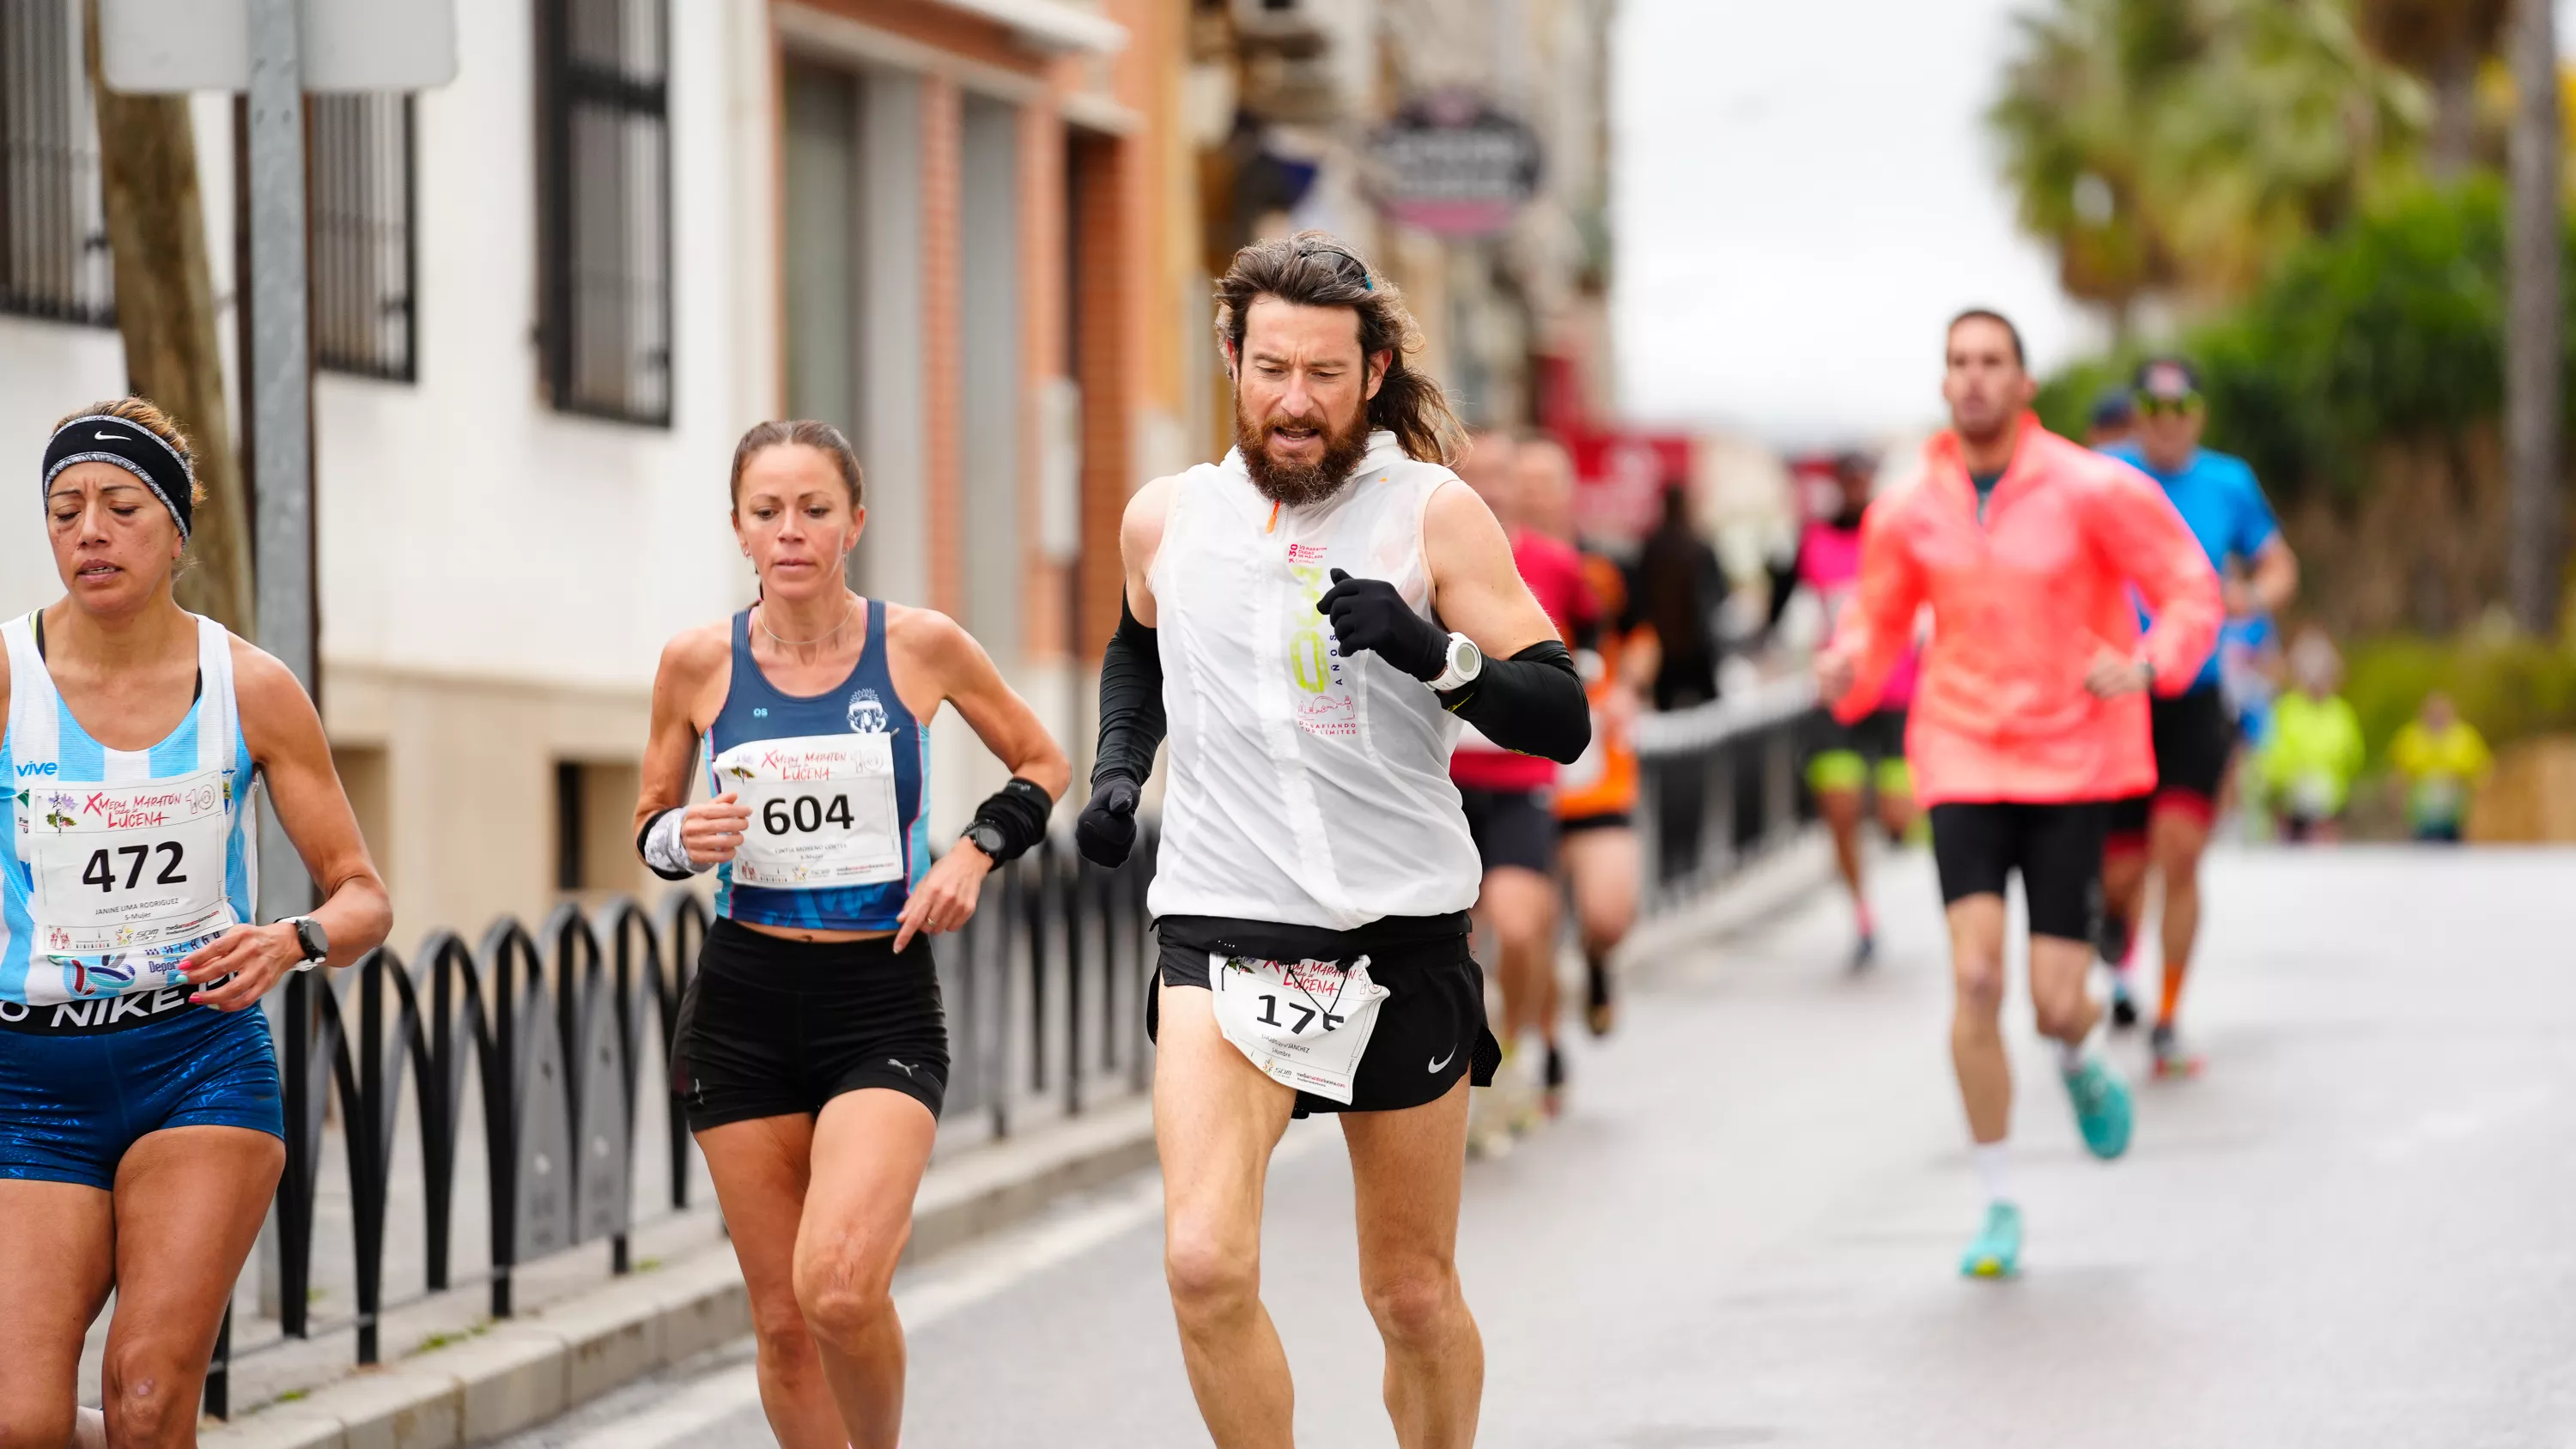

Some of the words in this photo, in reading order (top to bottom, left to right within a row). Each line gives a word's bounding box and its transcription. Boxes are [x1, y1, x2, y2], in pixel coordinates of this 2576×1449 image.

[753, 707, 769, 717] OS
[15, 761, 58, 777] vive
[782, 767, 831, 780] LUCENA
[107, 811, 171, 828] LUCENA
[762, 793, 854, 835] 604
[82, 840, 187, 893] 472
[95, 906, 119, 915] JANINE
[1283, 972, 1340, 996] LUCENA
[51, 989, 185, 1028] NIKE
